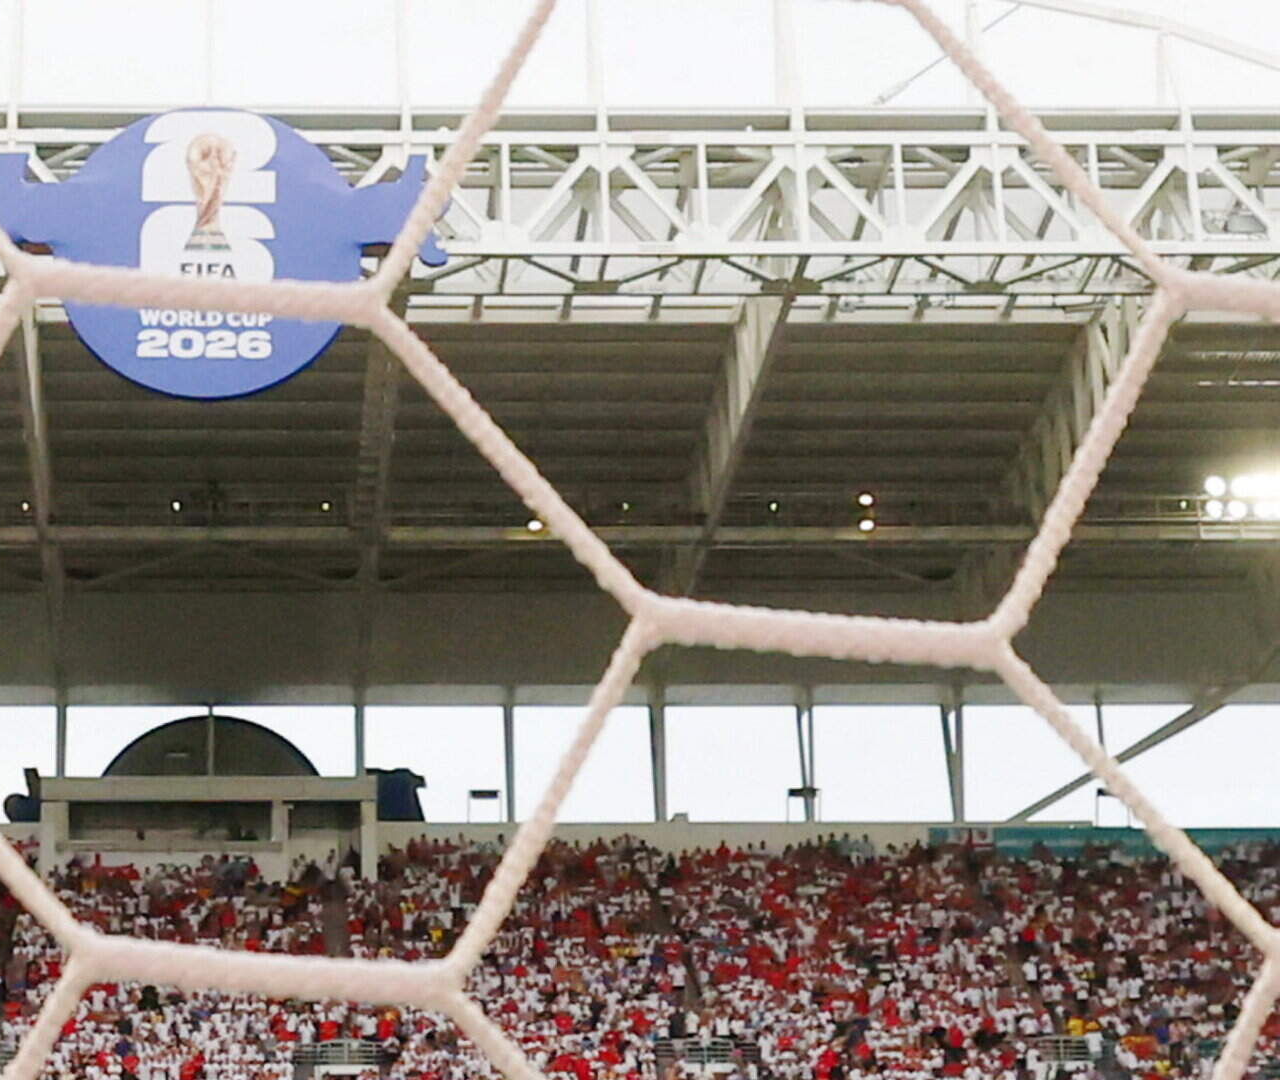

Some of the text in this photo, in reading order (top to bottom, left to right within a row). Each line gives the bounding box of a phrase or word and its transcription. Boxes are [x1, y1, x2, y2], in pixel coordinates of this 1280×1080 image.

[139, 308, 274, 328] WORLD CUP
[136, 328, 273, 359] 2026
